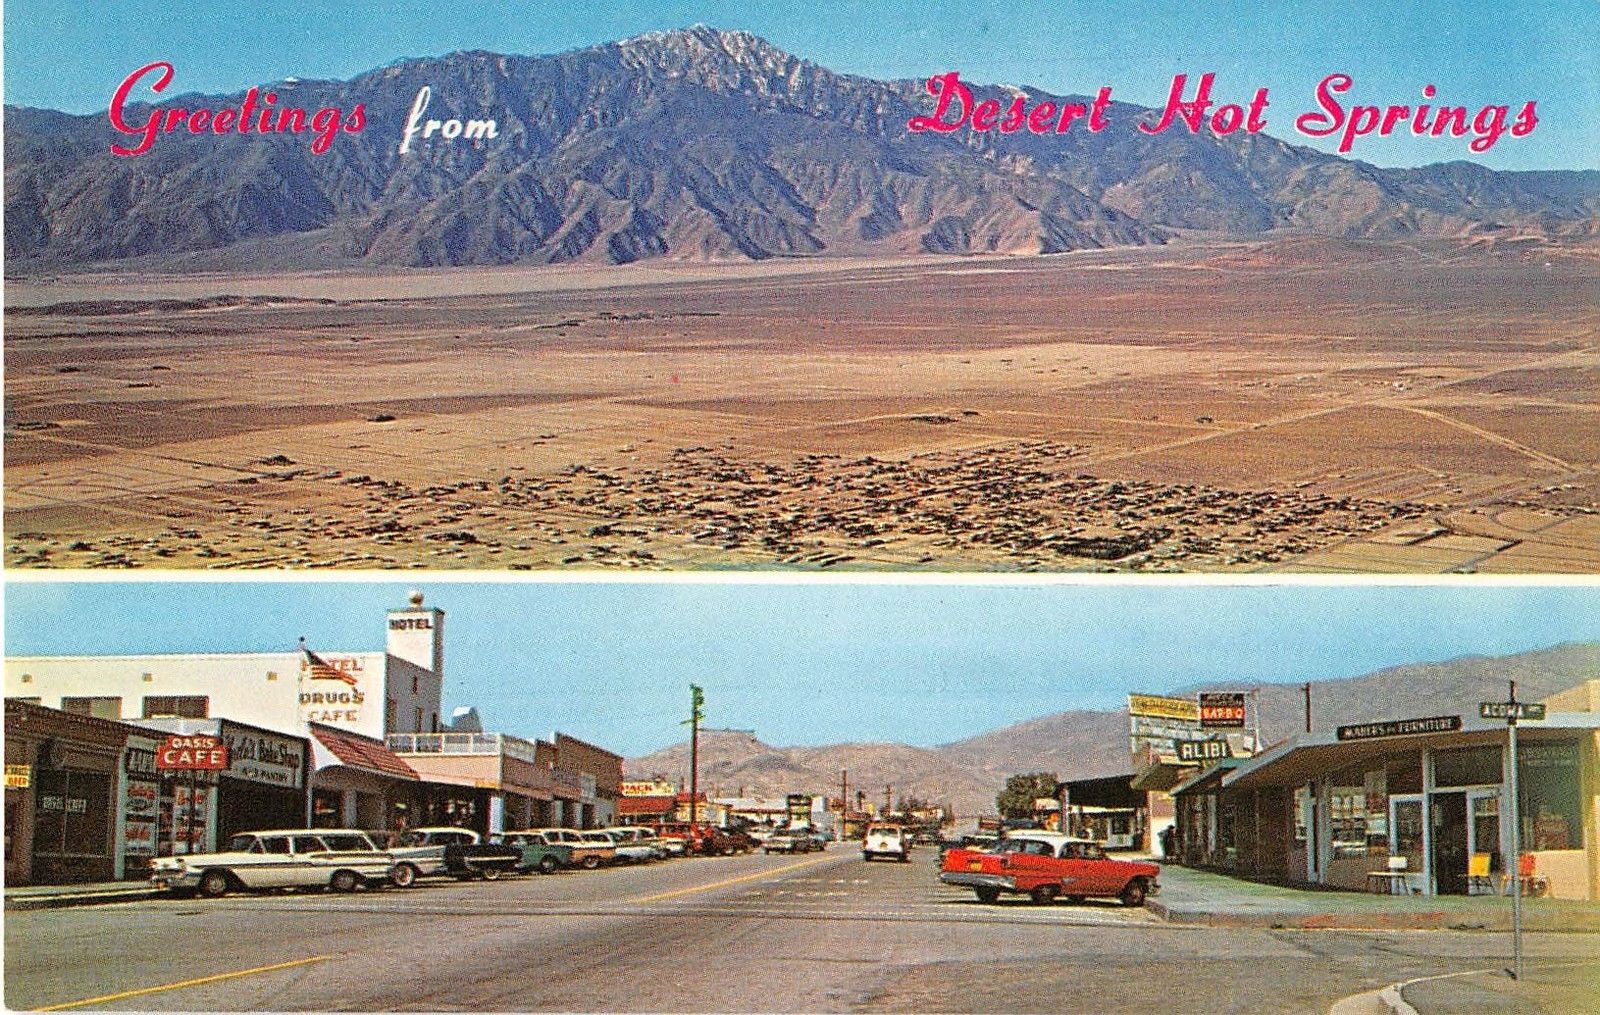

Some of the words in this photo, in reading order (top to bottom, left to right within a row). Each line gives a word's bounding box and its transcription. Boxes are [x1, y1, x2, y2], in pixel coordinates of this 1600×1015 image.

[389, 618, 433, 630] HOTEL
[300, 692, 364, 704] DRUGS
[308, 711, 358, 721] CAFE
[171, 738, 215, 748] OASIS
[164, 750, 223, 764] CAFE
[1183, 742, 1227, 760] ALIBI
